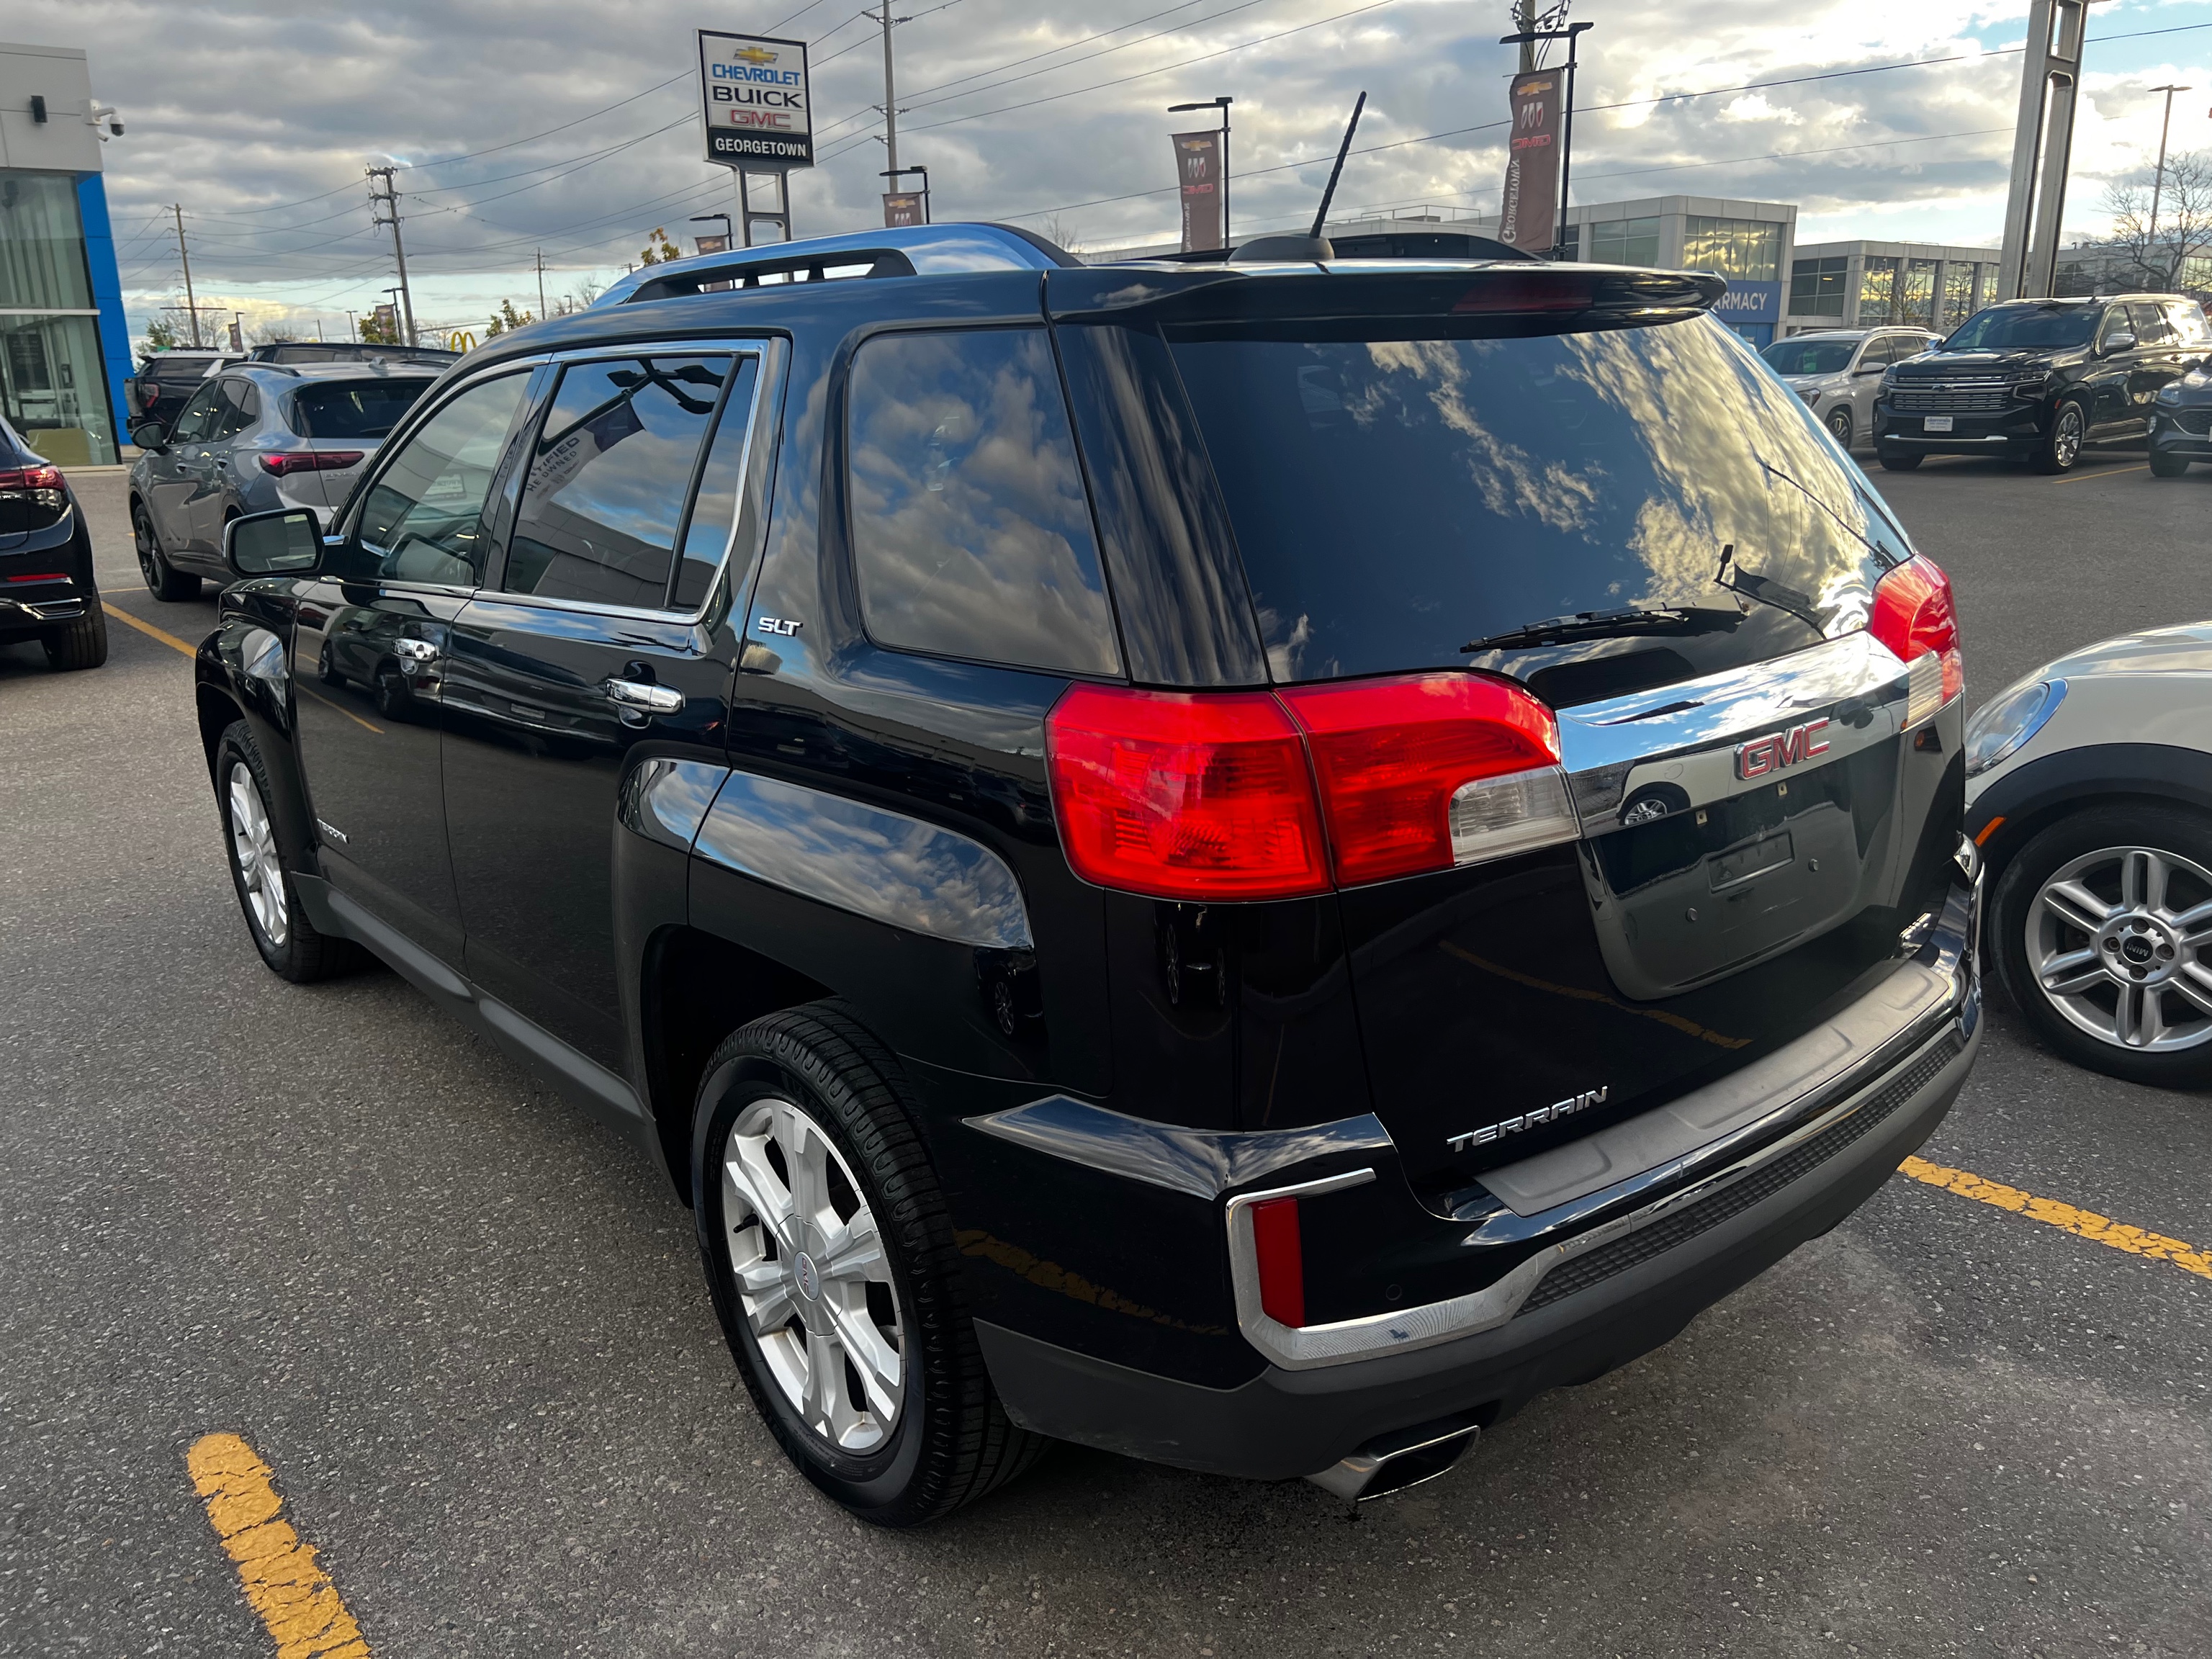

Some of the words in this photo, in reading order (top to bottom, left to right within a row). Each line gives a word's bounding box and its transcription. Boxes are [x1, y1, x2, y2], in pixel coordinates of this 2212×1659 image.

[712, 63, 801, 86] CHEVROLET
[712, 86, 803, 108] BUICK
[730, 109, 791, 130] GMC
[715, 138, 806, 157] GEORGETOWN
[541, 451, 577, 478] OWNED
[757, 616, 802, 637] SLT
[1734, 716, 1830, 781] GMC
[2126, 943, 2149, 958] MINI
[1447, 1086, 1608, 1152] TERRAIN
[801, 1256, 810, 1296] GMC
